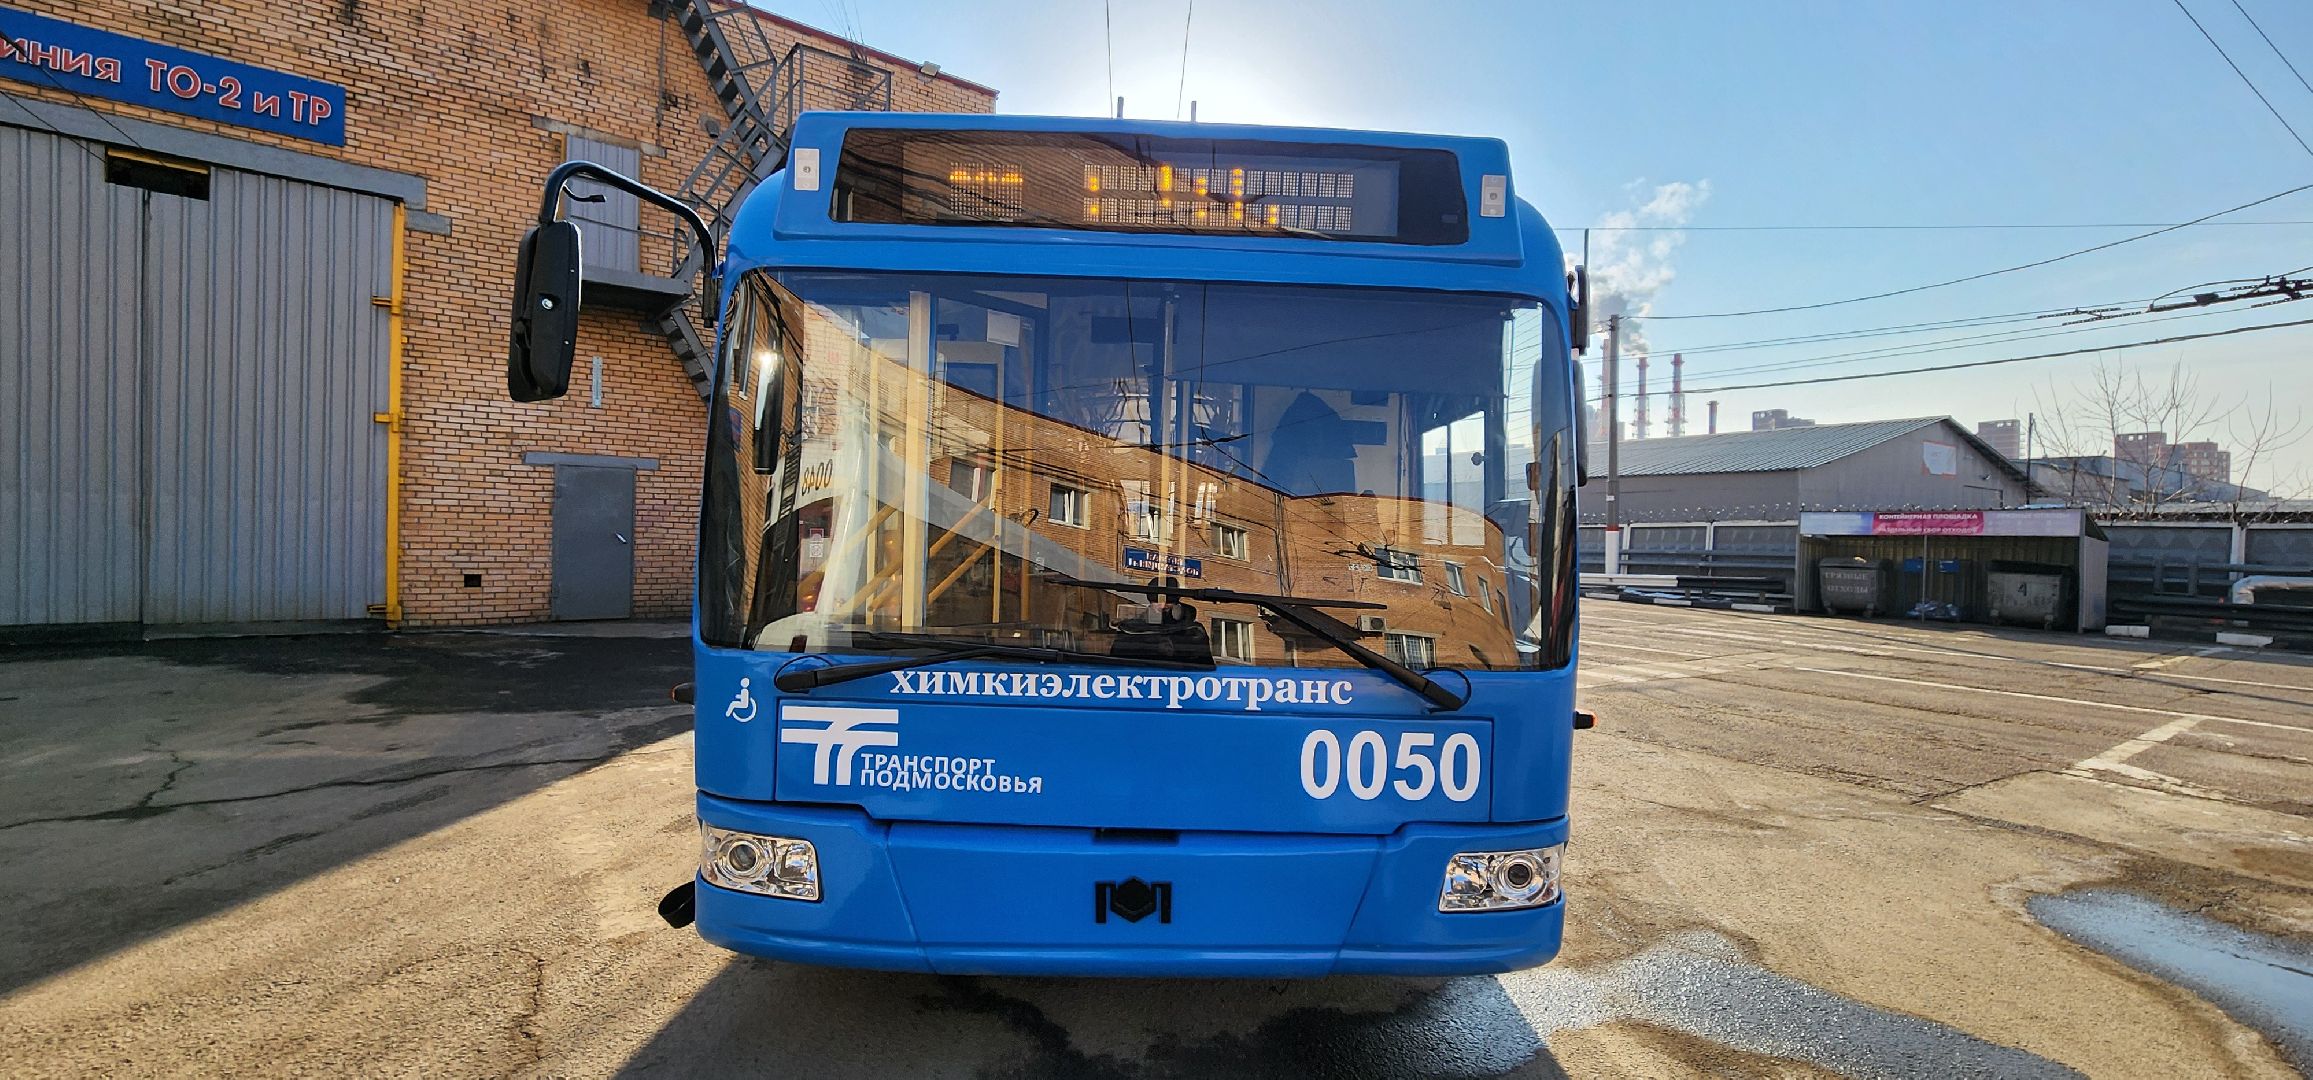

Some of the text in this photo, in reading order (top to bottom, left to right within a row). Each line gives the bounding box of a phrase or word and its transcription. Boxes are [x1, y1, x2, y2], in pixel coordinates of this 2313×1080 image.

[145, 58, 242, 109] ТО-2
[253, 91, 280, 117] и
[288, 91, 331, 125] ТР
[890, 670, 1353, 711] химкиэлектротранс
[860, 769, 1042, 794] ПОДМОСКОВЬЯ
[861, 753, 996, 776] ТРАНСПОРТ
[1300, 729, 1480, 802] 0050
